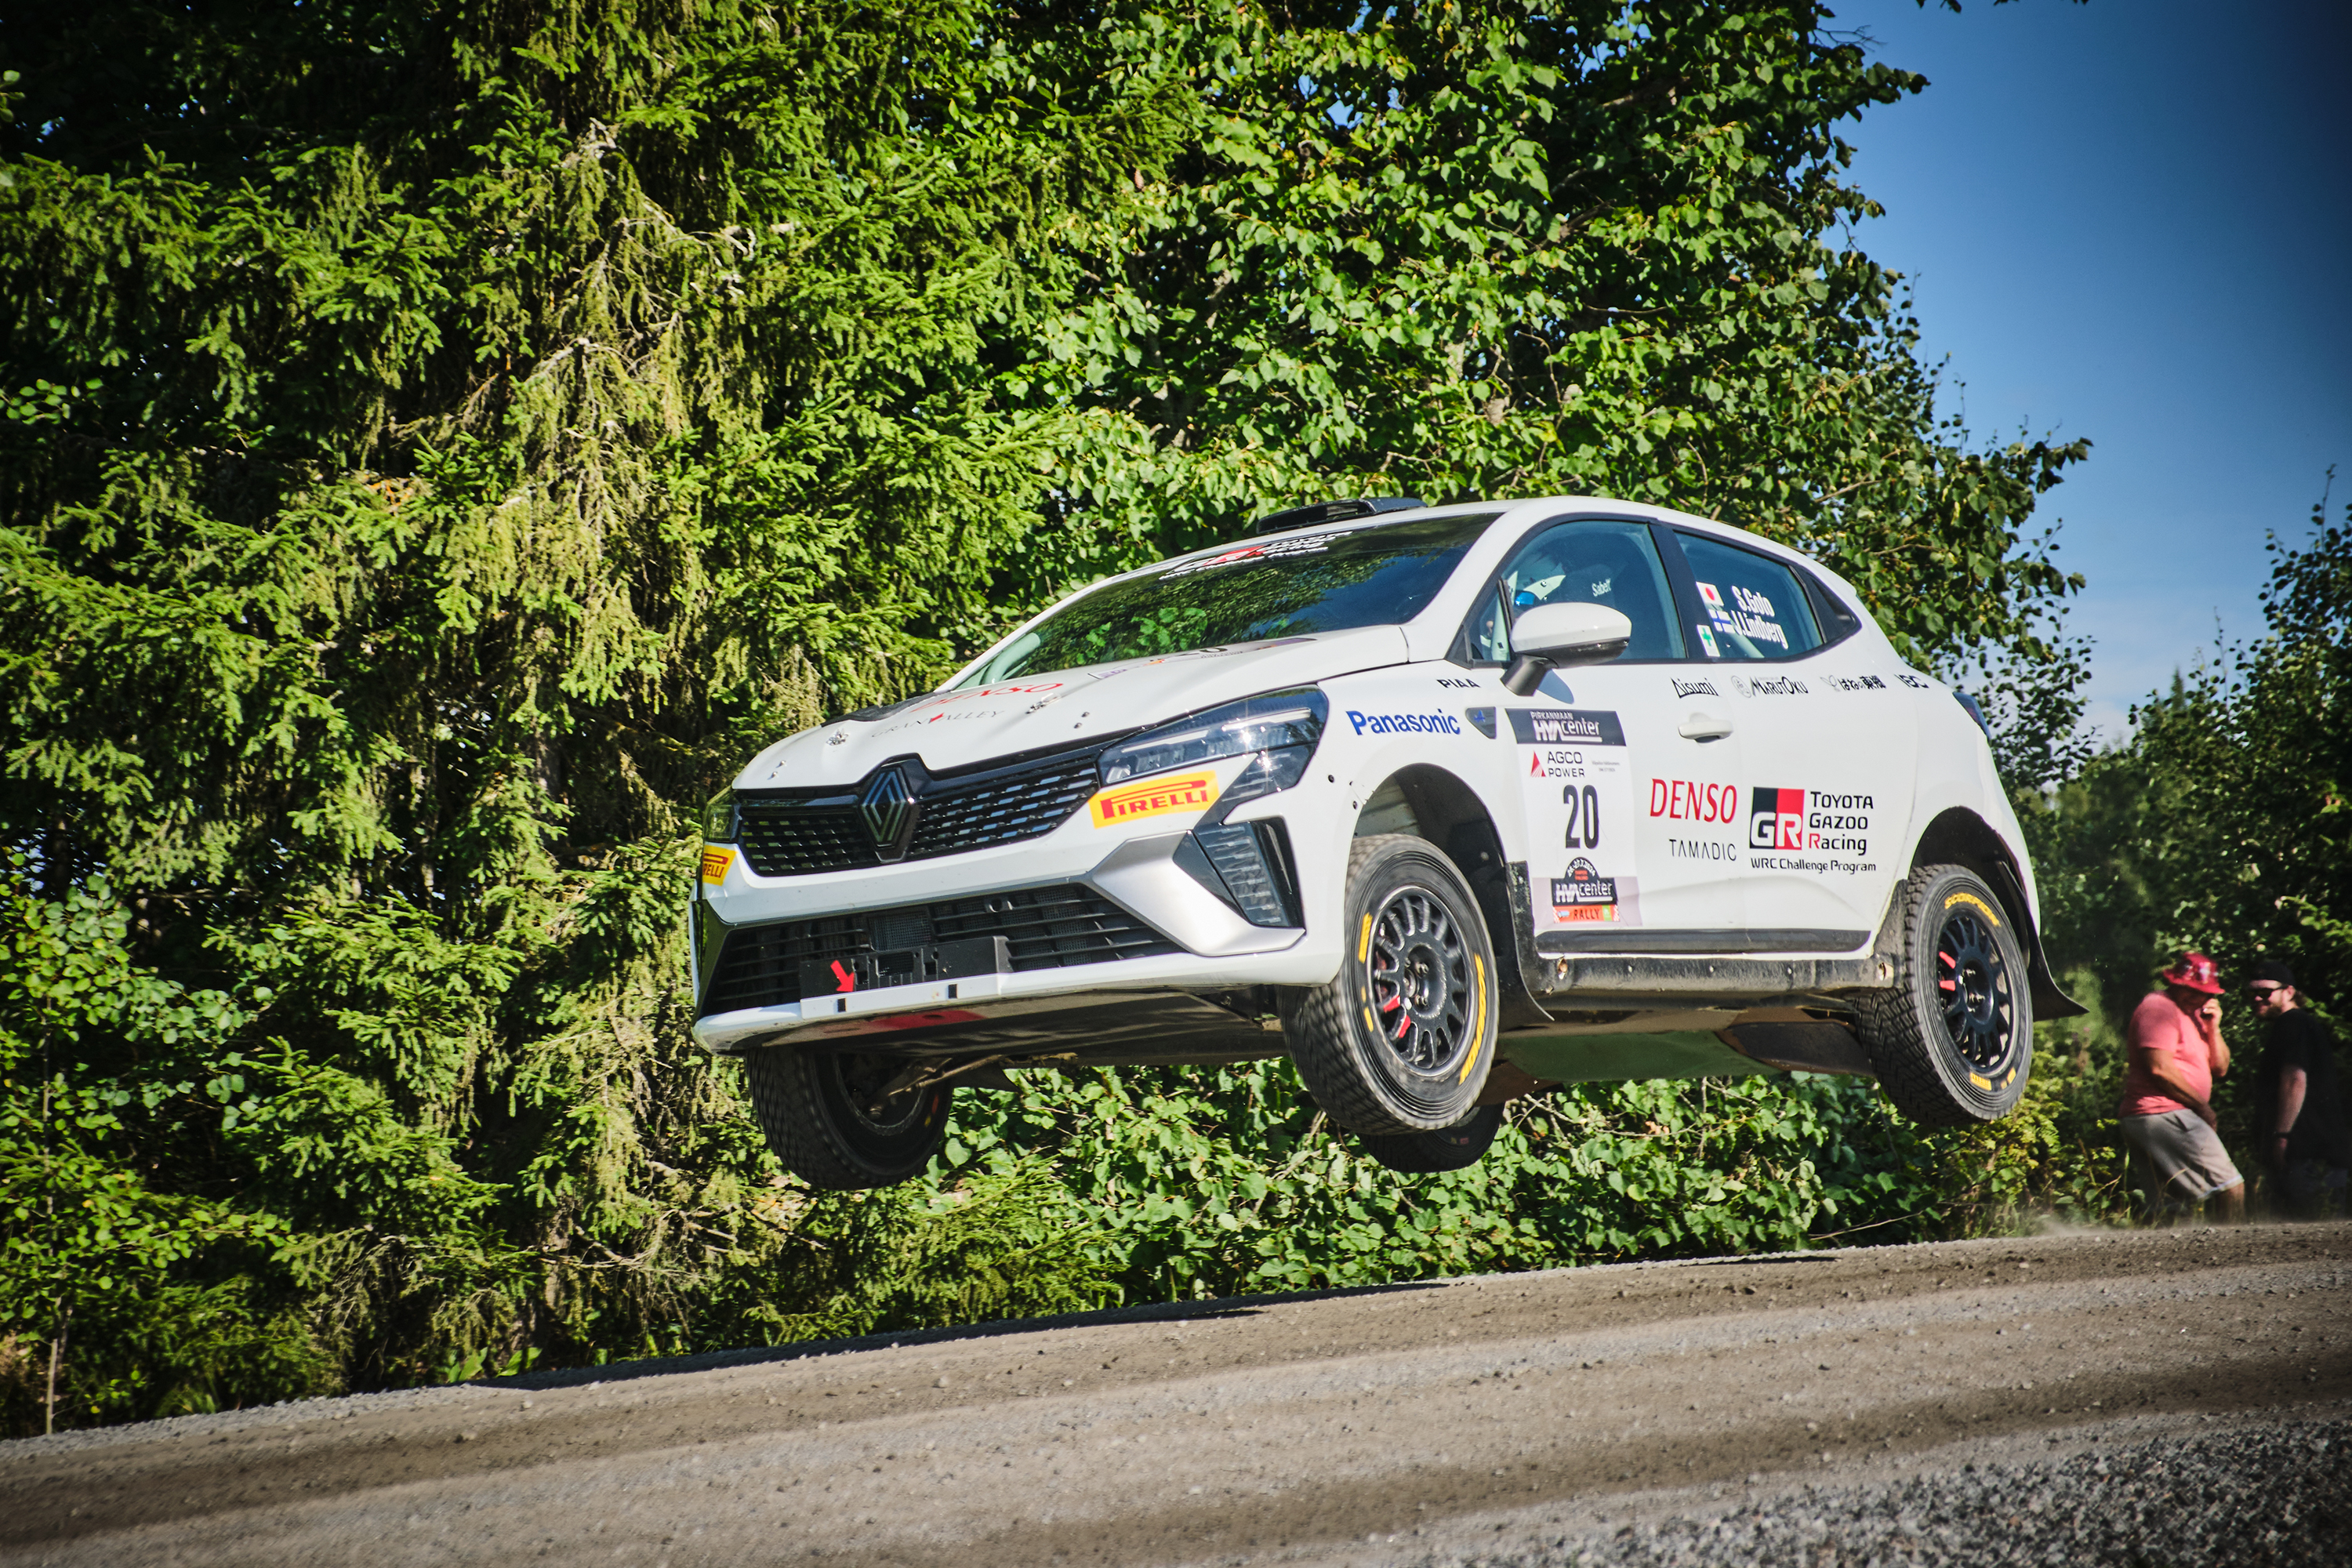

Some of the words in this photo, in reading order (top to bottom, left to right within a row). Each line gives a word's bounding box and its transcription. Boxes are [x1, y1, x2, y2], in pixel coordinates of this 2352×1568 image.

[1731, 585, 1775, 617] S.Goto
[1436, 679, 1481, 688] PIAA
[909, 683, 1065, 713] DENSO
[1346, 709, 1461, 735] Panasonic
[1530, 711, 1573, 720] PIRKANMAAN
[1548, 751, 1583, 764] AGCO
[1548, 768, 1585, 778] POWER
[1100, 779, 1209, 819] PIRELLI
[1650, 778, 1737, 824] DENSO
[1810, 791, 1874, 809] TOYOTA
[1563, 784, 1599, 849] 20
[1809, 812, 1868, 829] GAZOO
[1750, 811, 1802, 848] GR
[1668, 839, 1737, 861] TAMADIC
[1809, 833, 1867, 855] Racing
[1751, 857, 1777, 869] WRC
[1779, 858, 1828, 874] Challenge
[1831, 859, 1877, 875] Program
[1573, 909, 1600, 920] RALLY
